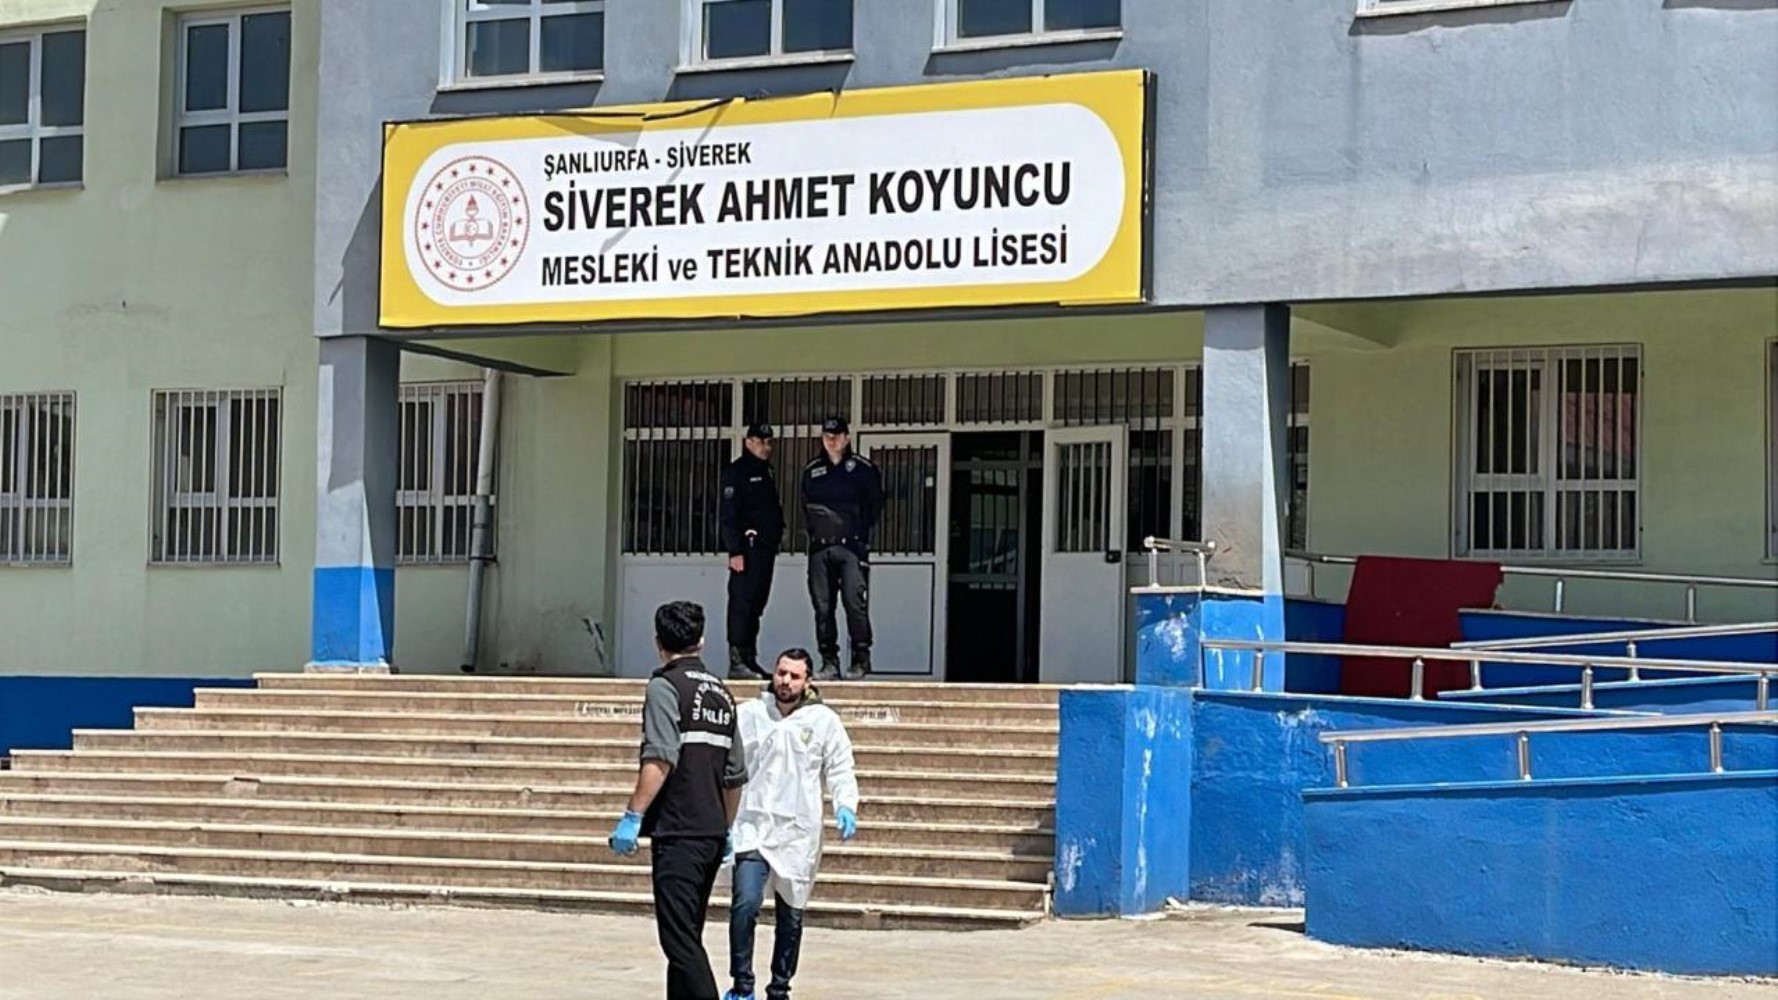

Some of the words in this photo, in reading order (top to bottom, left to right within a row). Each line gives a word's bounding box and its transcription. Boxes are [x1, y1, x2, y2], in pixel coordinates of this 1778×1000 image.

[544, 149, 649, 181] ŞANLIURFA
[667, 142, 751, 169] SİVEREK
[543, 179, 705, 231] SİVEREK
[717, 174, 855, 223] AHMET
[869, 161, 1071, 215] KOYUNCU
[541, 245, 659, 287] MESLEKİ
[668, 258, 698, 282] ve
[707, 238, 813, 280] TEKNİK
[822, 236, 962, 275] ANADOLU
[973, 224, 1067, 268] LİSESİ
